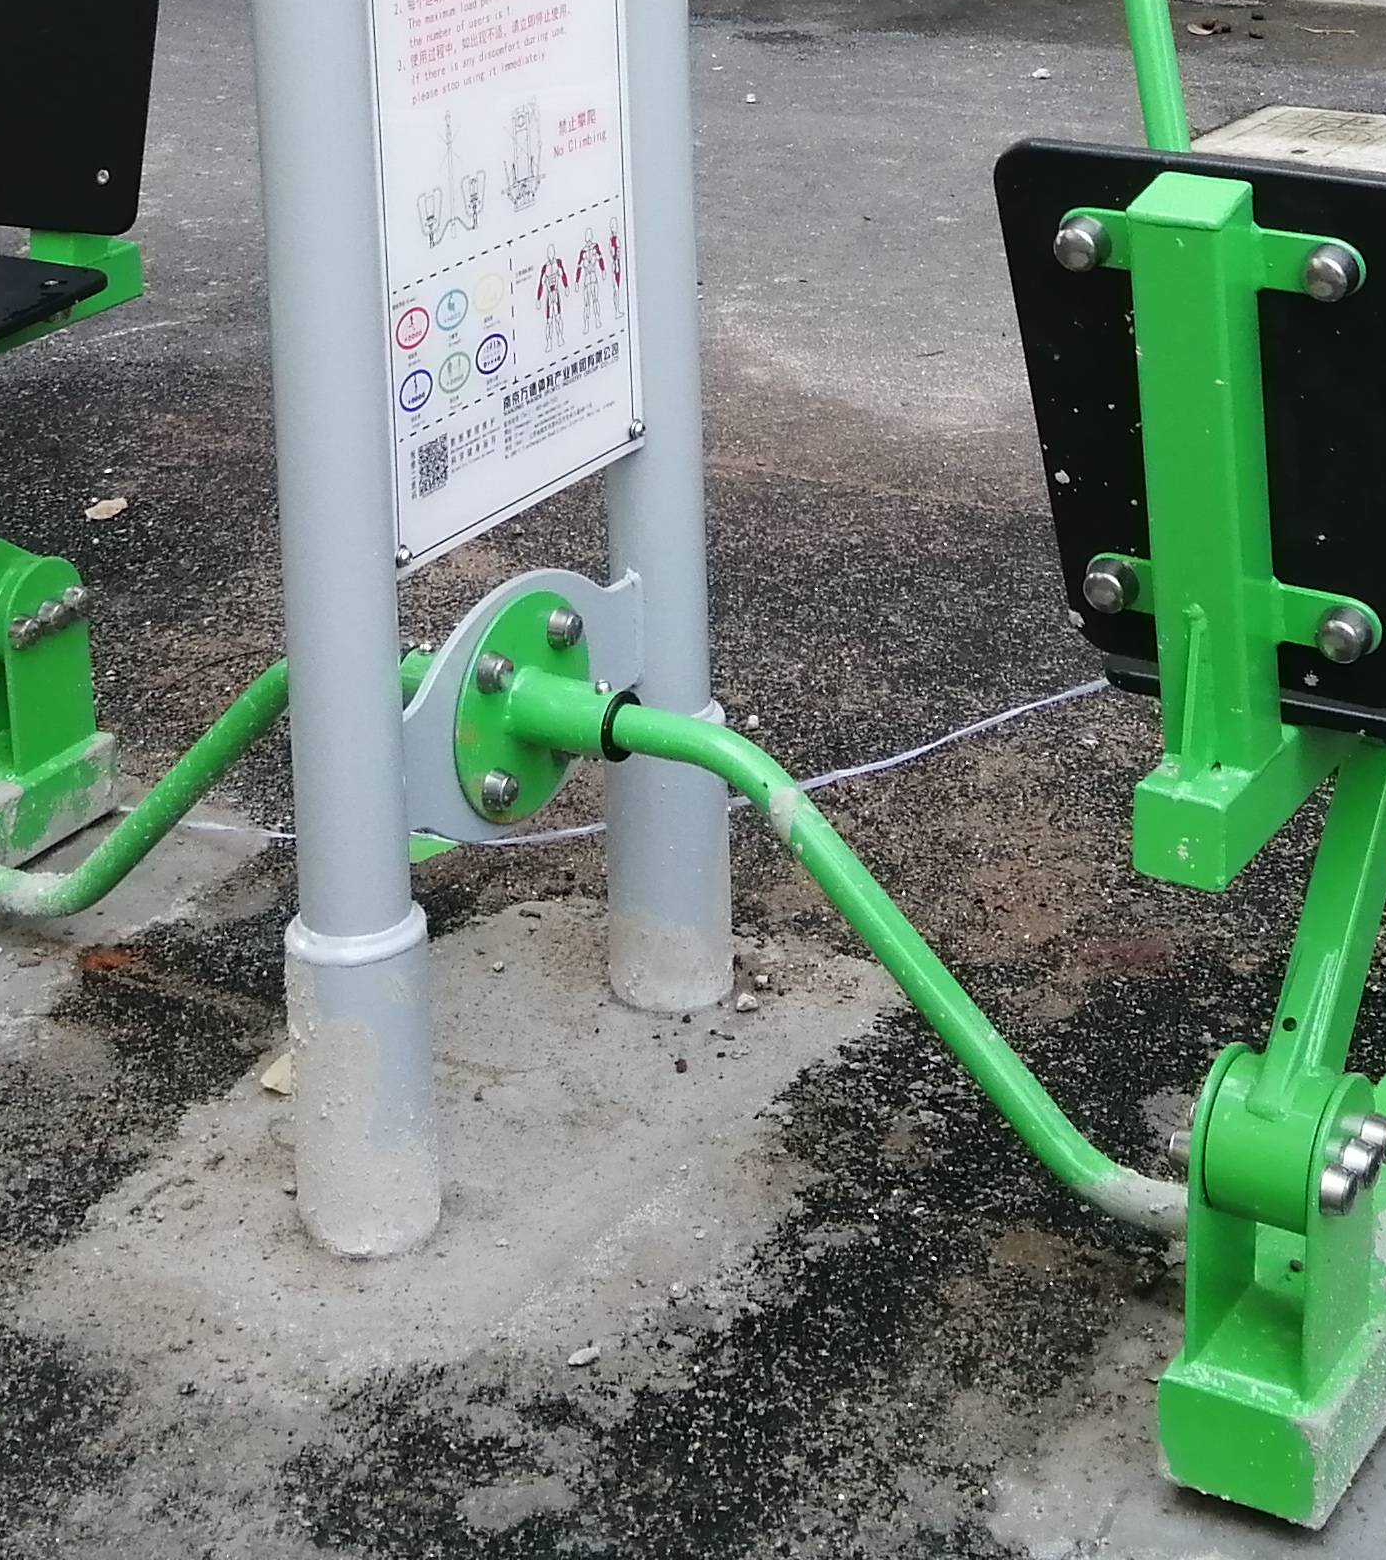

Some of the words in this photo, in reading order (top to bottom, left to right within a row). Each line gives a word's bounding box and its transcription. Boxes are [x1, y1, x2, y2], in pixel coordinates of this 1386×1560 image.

[407, 17, 421, 29] The
[409, 36, 422, 48] the
[426, 27, 451, 42] number
[456, 19, 464, 33] of
[468, 15, 490, 29] users
[495, 11, 502, 20] is
[411, 72, 420, 85] If
[424, 67, 445, 81] there
[450, 62, 458, 71] is
[462, 57, 475, 68] any
[479, 40, 520, 62] discomfort
[523, 31, 548, 46] during
[412, 88, 438, 105] please
[442, 81, 459, 93] stop
[463, 71, 484, 86] using
[489, 66, 496, 76] it
[553, 145, 564, 157] No
[568, 130, 606, 152] Climbing
